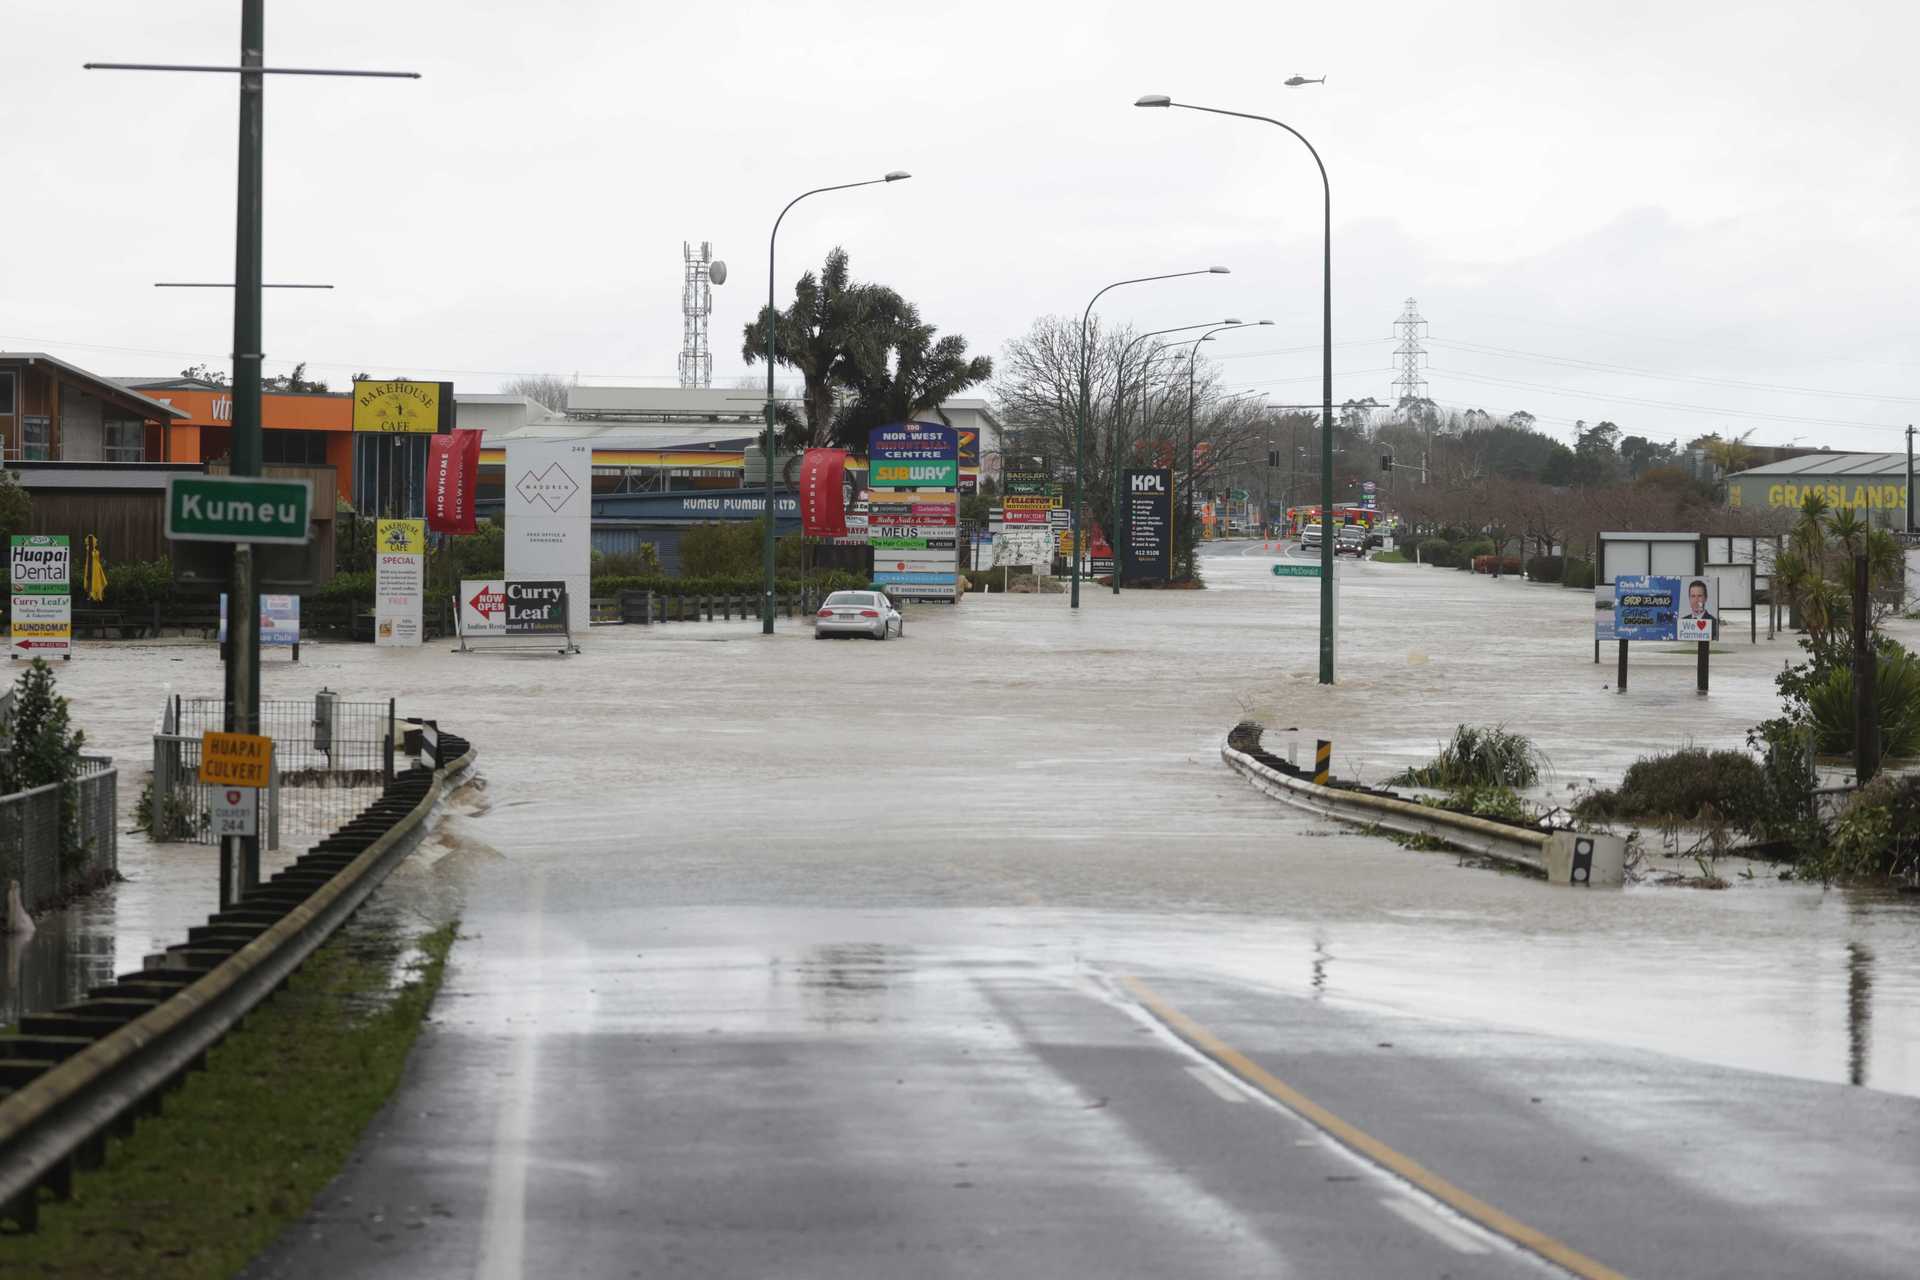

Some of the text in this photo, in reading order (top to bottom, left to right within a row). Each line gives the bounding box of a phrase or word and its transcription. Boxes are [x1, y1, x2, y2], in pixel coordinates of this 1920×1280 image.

[360, 383, 434, 409] BAKEHOUSE
[381, 421, 411, 432] CAFE
[876, 466, 951, 480] SUBWAY
[437, 453, 449, 518] SHOWHOME
[1132, 474, 1164, 492] KPL
[181, 494, 296, 524] Kumeu
[683, 499, 720, 510] KUMEU
[779, 499, 796, 510] LTD
[380, 521, 418, 536] BAKEHOUSE
[881, 528, 918, 537] MEUS
[390, 544, 408, 552] CAFE
[13, 547, 68, 564] Huapai
[382, 557, 416, 565] SPECIAL
[14, 564, 66, 580] Dental
[479, 594, 502, 602] NOW
[507, 584, 562, 602] Curry
[13, 598, 38, 606] Curry
[478, 603, 504, 611] OPEN
[1624, 597, 1642, 606] STOP
[509, 605, 552, 620] Leaf
[14, 624, 68, 632] LAUNDROMAT
[1682, 622, 1696, 630] We
[1680, 631, 1709, 639] Farmers
[210, 739, 262, 758] HUAPAI
[206, 760, 263, 780] CULVERT
